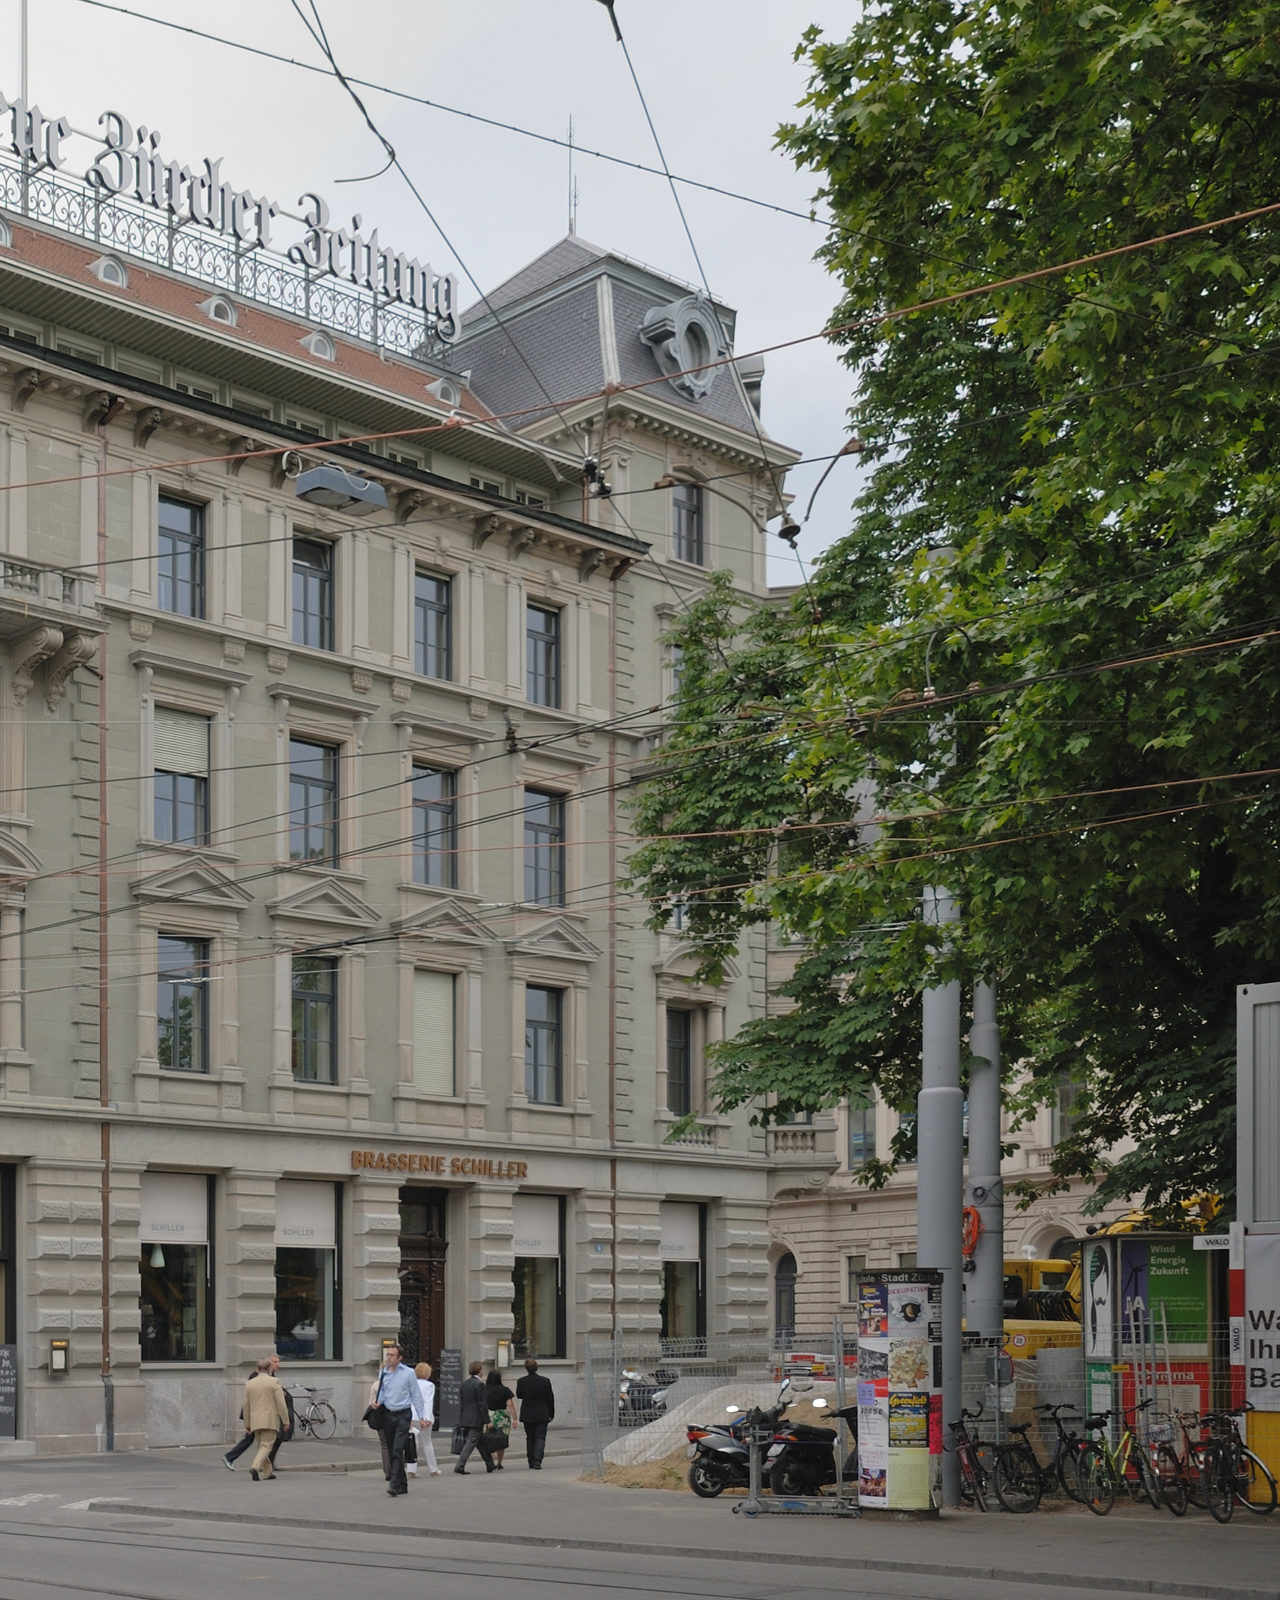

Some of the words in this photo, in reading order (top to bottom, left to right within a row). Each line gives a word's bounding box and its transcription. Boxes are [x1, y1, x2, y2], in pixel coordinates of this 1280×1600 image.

[86, 111, 280, 248] Zürcher
[288, 192, 462, 344] Zeitung
[351, 1150, 446, 1174] BRASSERIE
[451, 1157, 528, 1178] SCHILLER
[151, 1223, 184, 1233] SCHILLER
[282, 1228, 314, 1237] SCHILLER
[1205, 1238, 1229, 1246] WALO
[1150, 1245, 1175, 1253] Wind
[1150, 1256, 1186, 1266] Energie
[1150, 1267, 1189, 1275] Zukunft
[881, 1273, 909, 1282] Stadt
